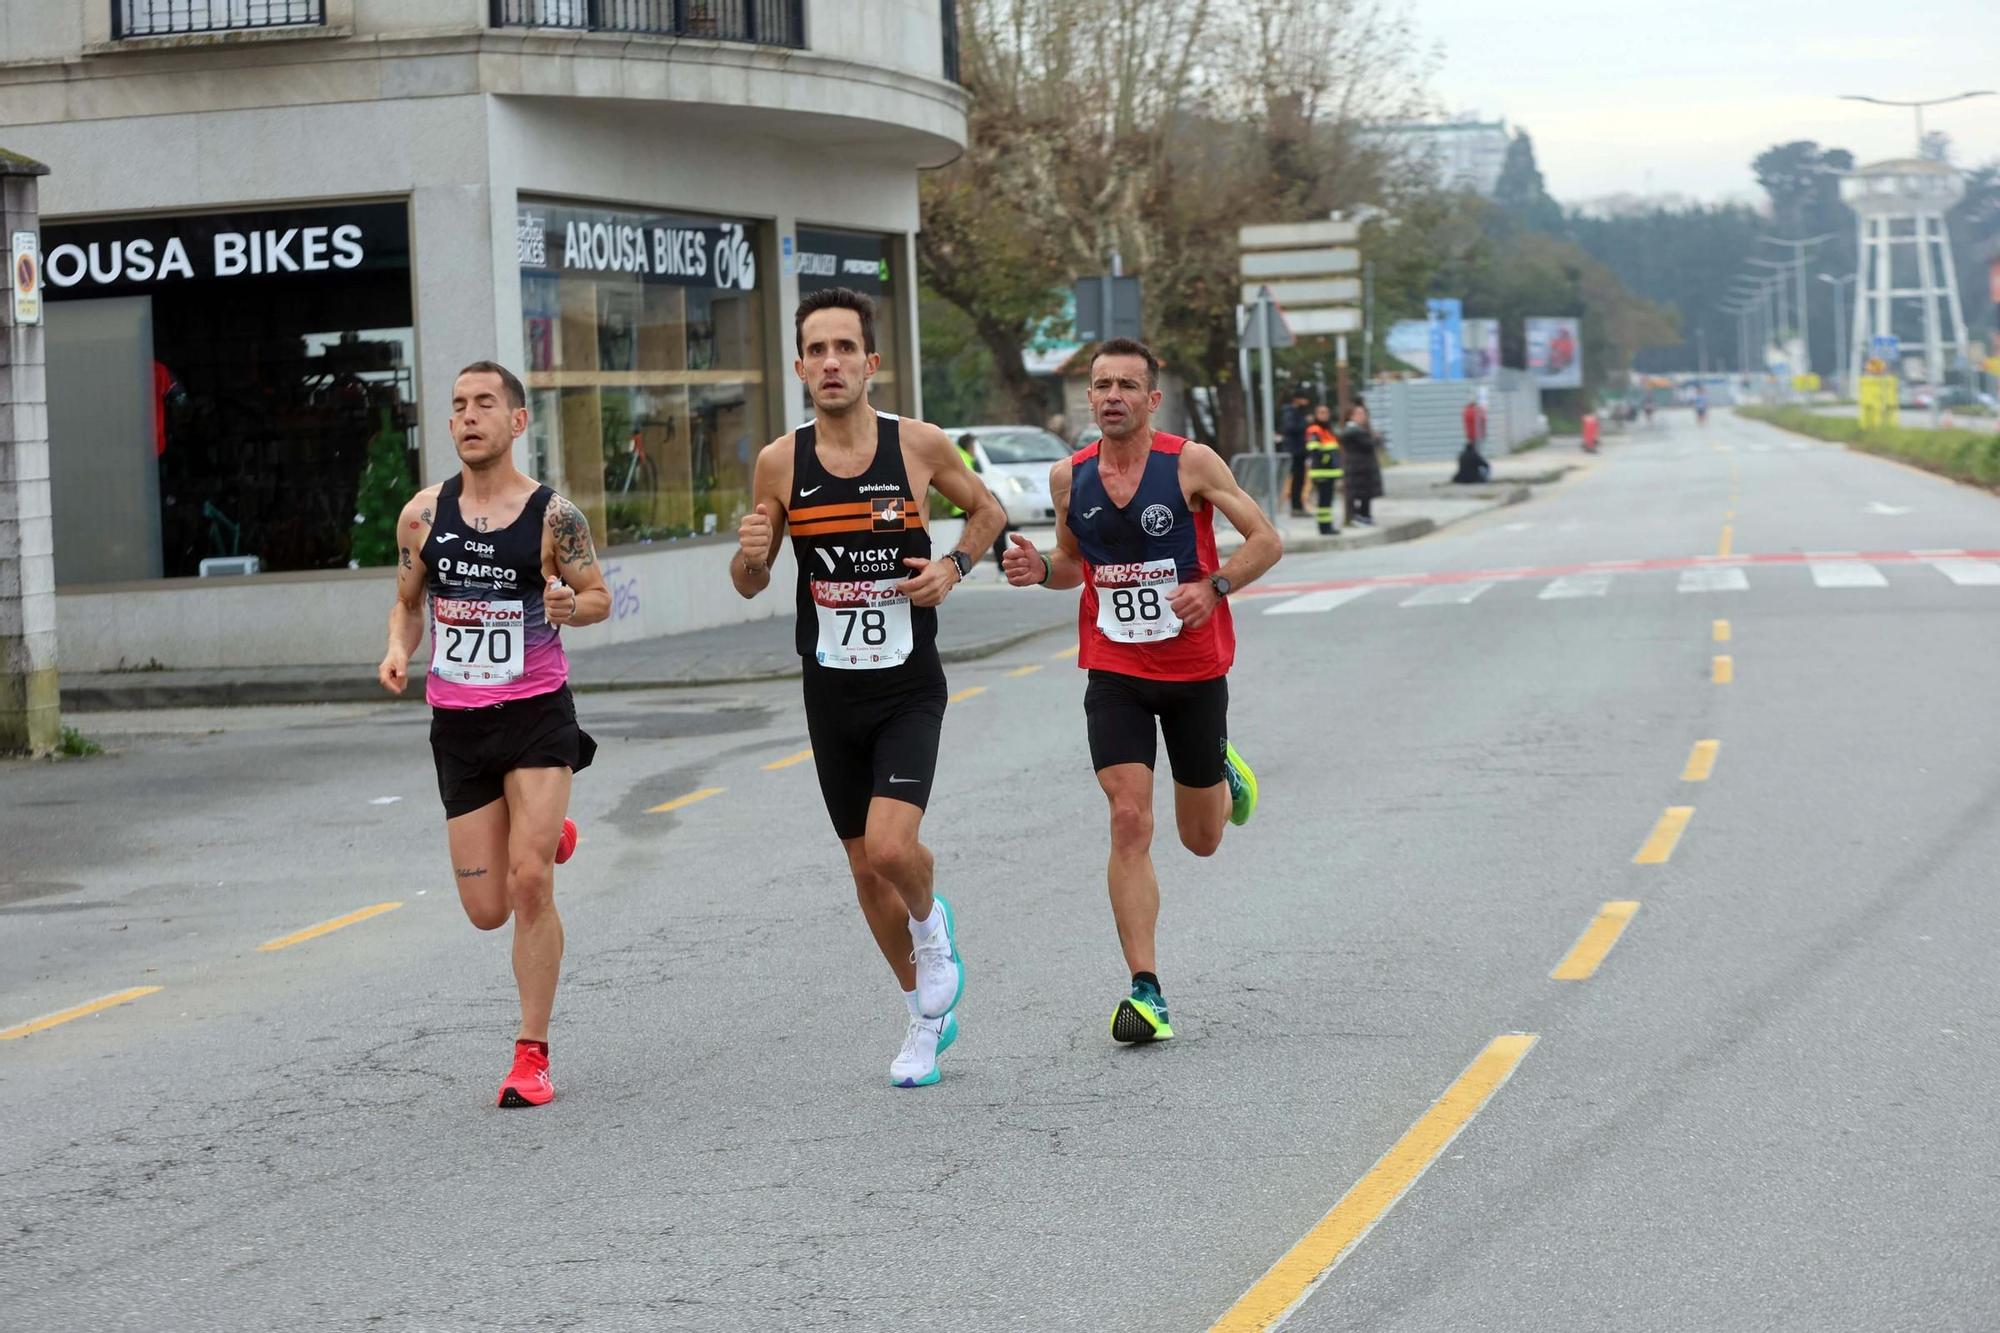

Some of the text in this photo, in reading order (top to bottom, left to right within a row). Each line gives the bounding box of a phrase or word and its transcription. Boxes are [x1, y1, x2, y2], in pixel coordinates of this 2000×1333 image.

[40, 224, 364, 288] OUSA BIKES
[564, 220, 707, 277] AROUSA BIKES
[473, 517, 488, 532] 13
[849, 547, 899, 563] VICKY
[438, 557, 517, 581] O BARCO
[854, 562, 895, 573] FOODS
[1095, 563, 1142, 575] MEDIO
[1095, 568, 1174, 583] MARATÓN
[816, 581, 874, 591] MEDIO
[437, 599, 490, 611] MEDIO
[1112, 588, 1161, 622] 88
[438, 608, 522, 620] MARATÓN
[835, 610, 886, 646] 78
[446, 627, 511, 663] 270
